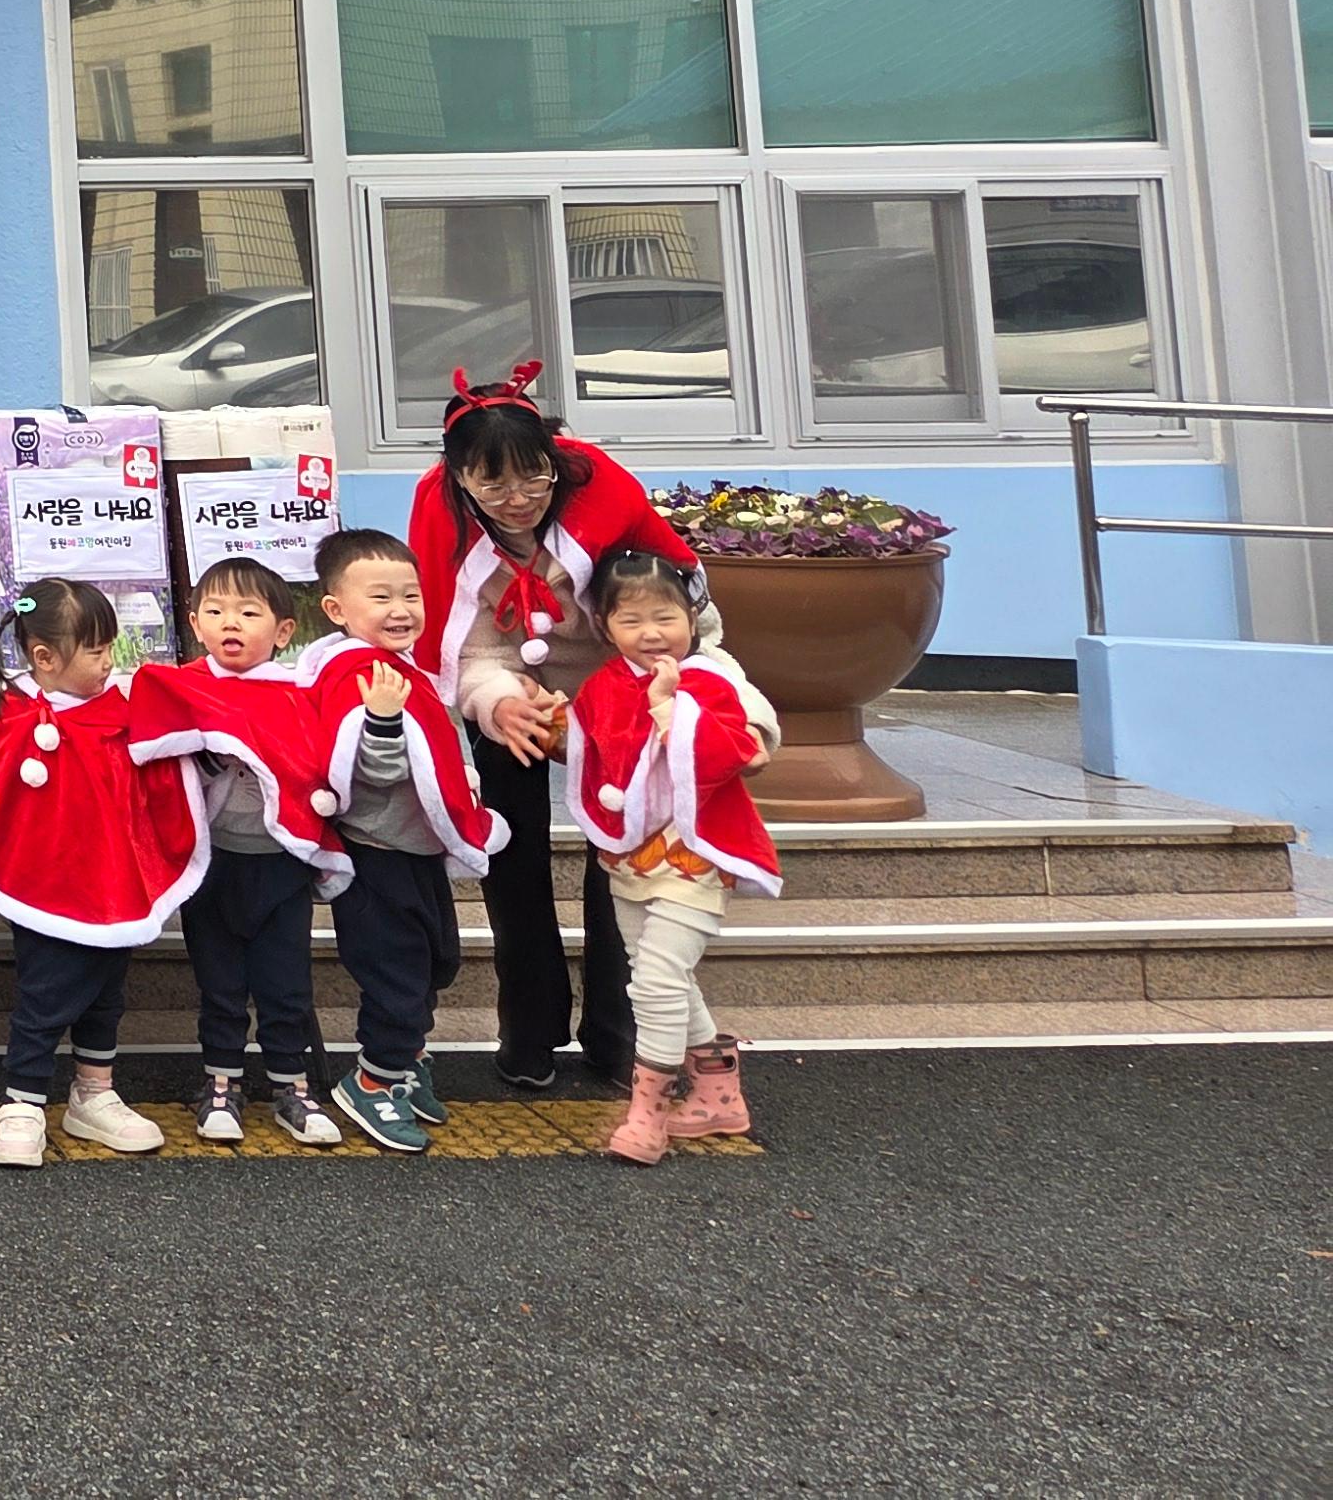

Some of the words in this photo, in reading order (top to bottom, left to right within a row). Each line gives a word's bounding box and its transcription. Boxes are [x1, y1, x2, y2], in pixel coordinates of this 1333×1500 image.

[22, 498, 84, 526] 사랑을
[94, 496, 154, 522] 나눠요
[195, 500, 260, 530] 사랑을
[270, 498, 330, 523] 나눠요
